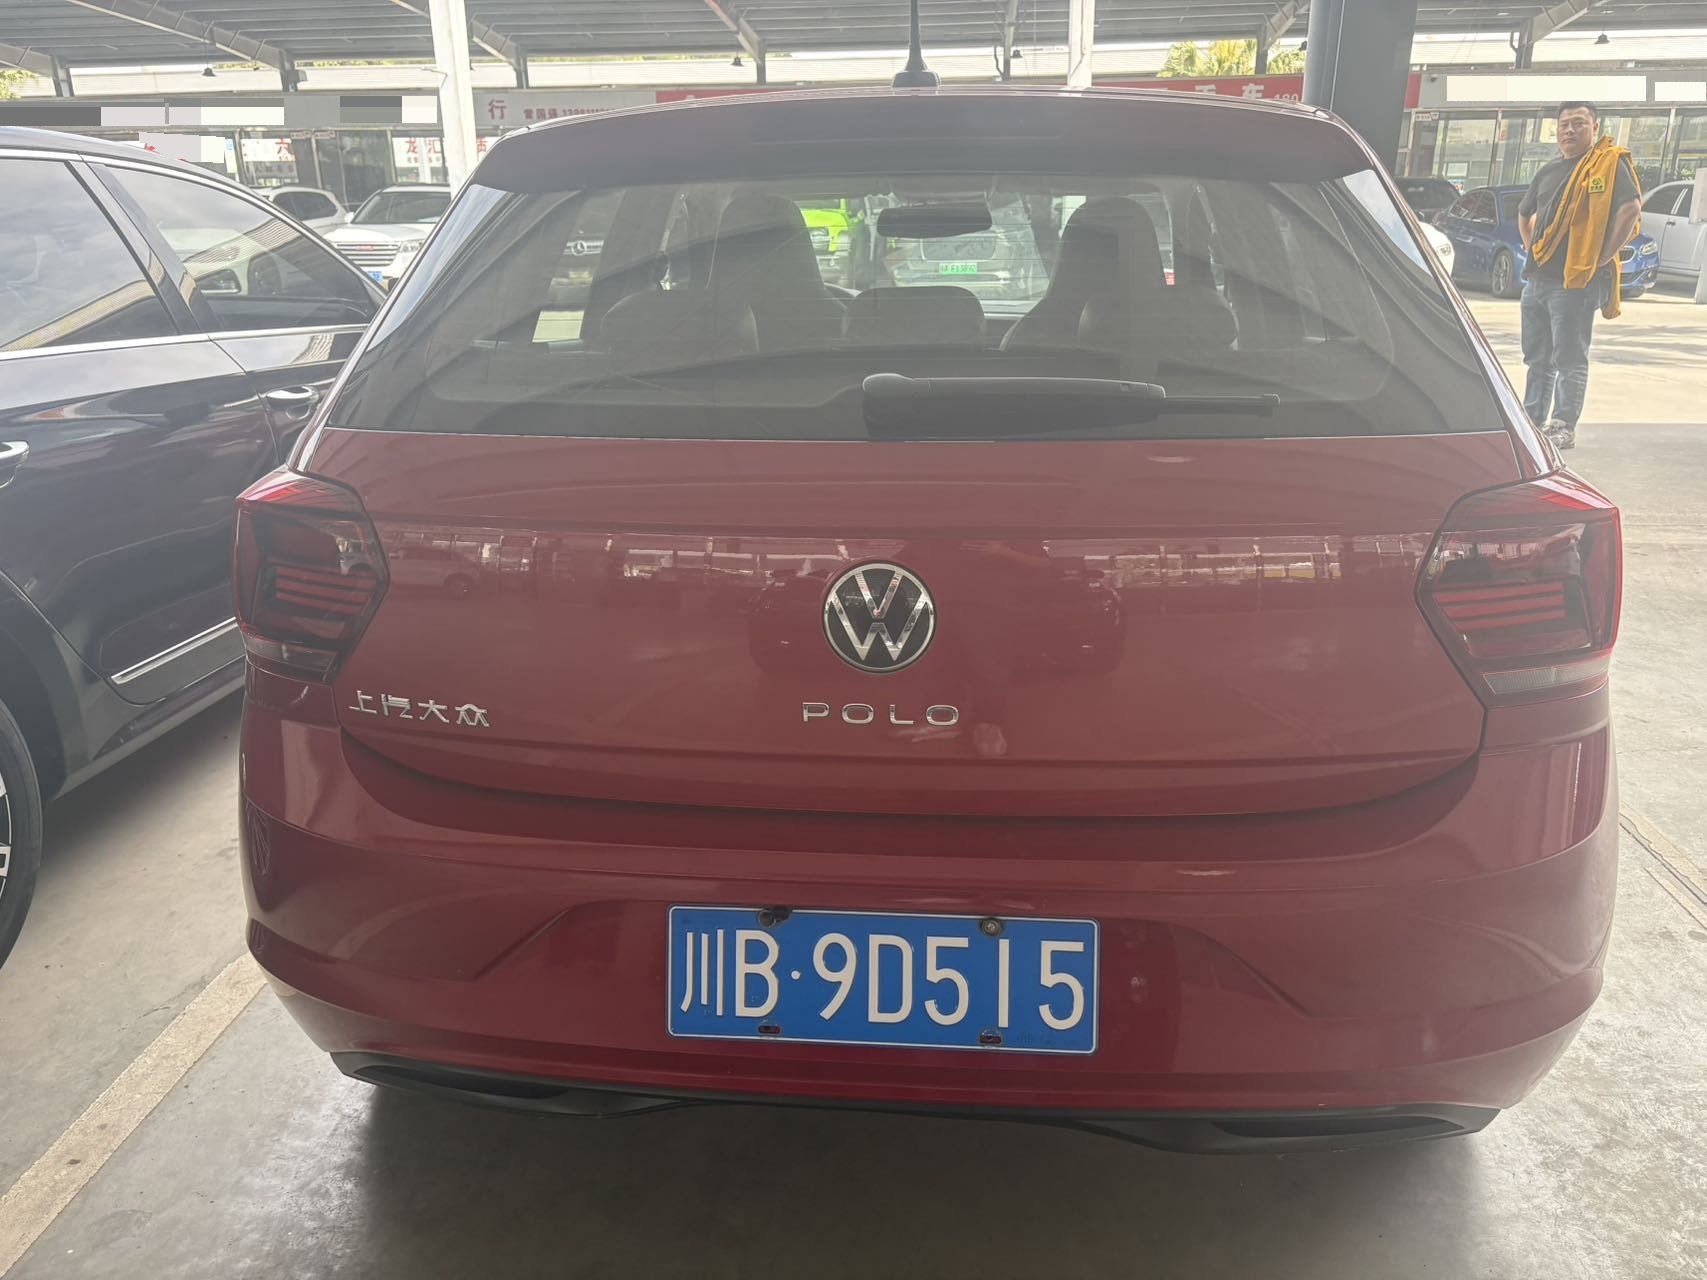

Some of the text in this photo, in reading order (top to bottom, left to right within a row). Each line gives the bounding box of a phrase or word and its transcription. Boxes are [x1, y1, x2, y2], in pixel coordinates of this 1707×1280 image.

[487, 99, 507, 120] 行
[348, 690, 490, 727] 上汽大众
[802, 702, 959, 726] POLO
